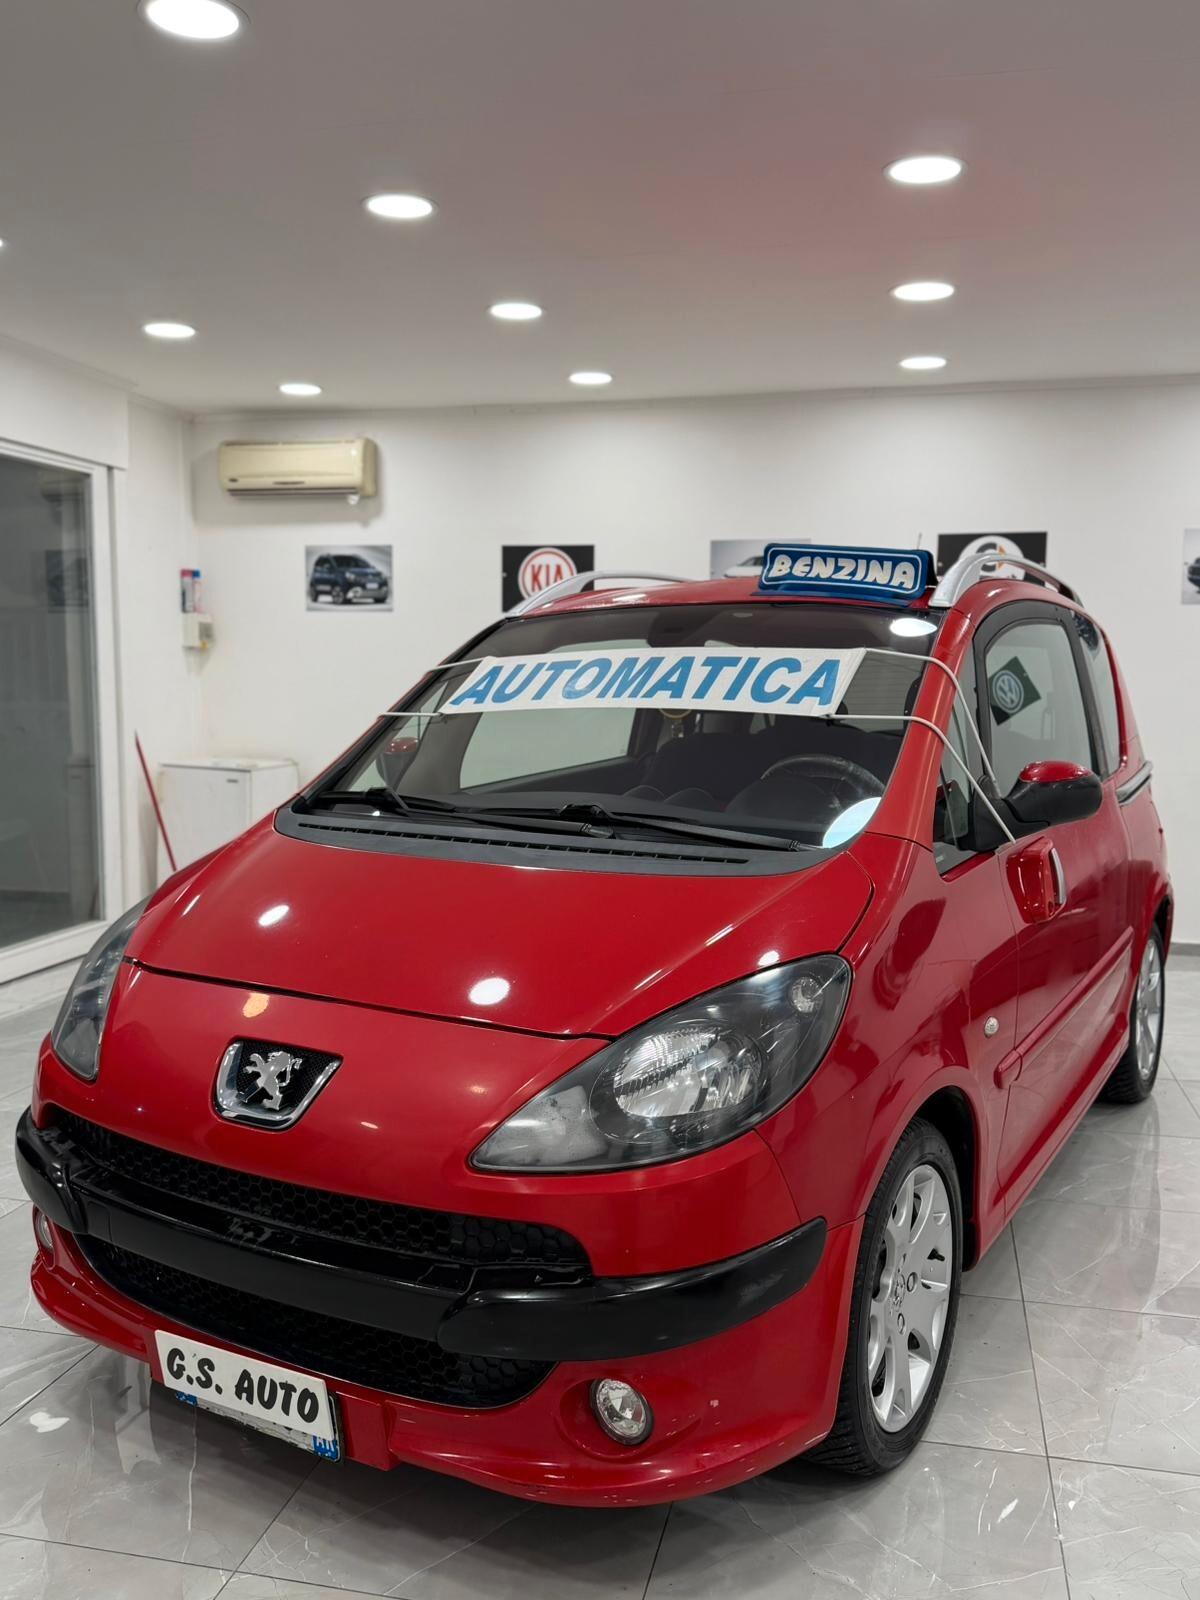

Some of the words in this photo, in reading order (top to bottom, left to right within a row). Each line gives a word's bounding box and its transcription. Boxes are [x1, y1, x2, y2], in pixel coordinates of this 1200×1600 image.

[530, 563, 564, 593] KIA
[768, 554, 915, 590] BENZINA
[449, 656, 842, 706] AUTOMATICA
[167, 1347, 223, 1395] G.S.
[235, 1369, 319, 1423] AUTO
